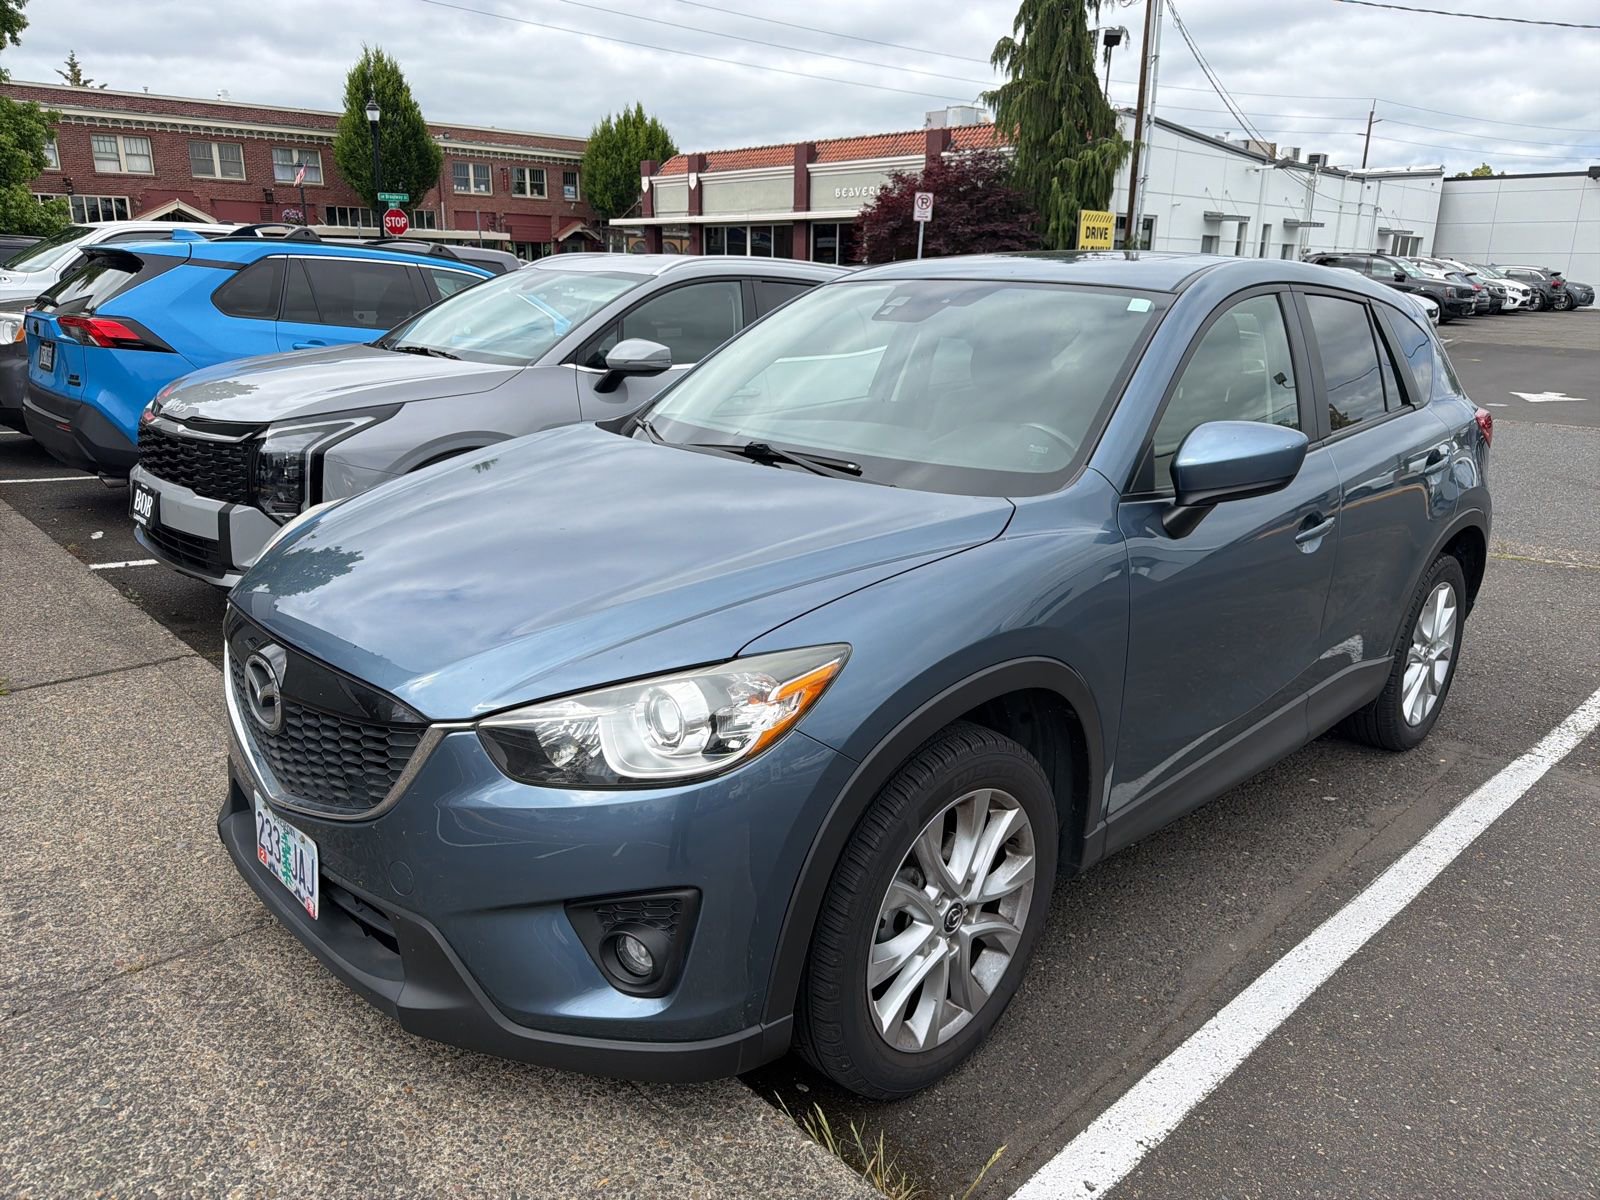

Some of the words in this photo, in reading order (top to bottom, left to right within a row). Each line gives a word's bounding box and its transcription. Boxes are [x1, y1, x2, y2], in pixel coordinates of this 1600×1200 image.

[385, 216, 407, 228] STOP
[1085, 226, 1109, 240] DRIVE
[133, 488, 154, 518] BOB
[257, 810, 282, 865] 233
[291, 843, 315, 898] JAJ
